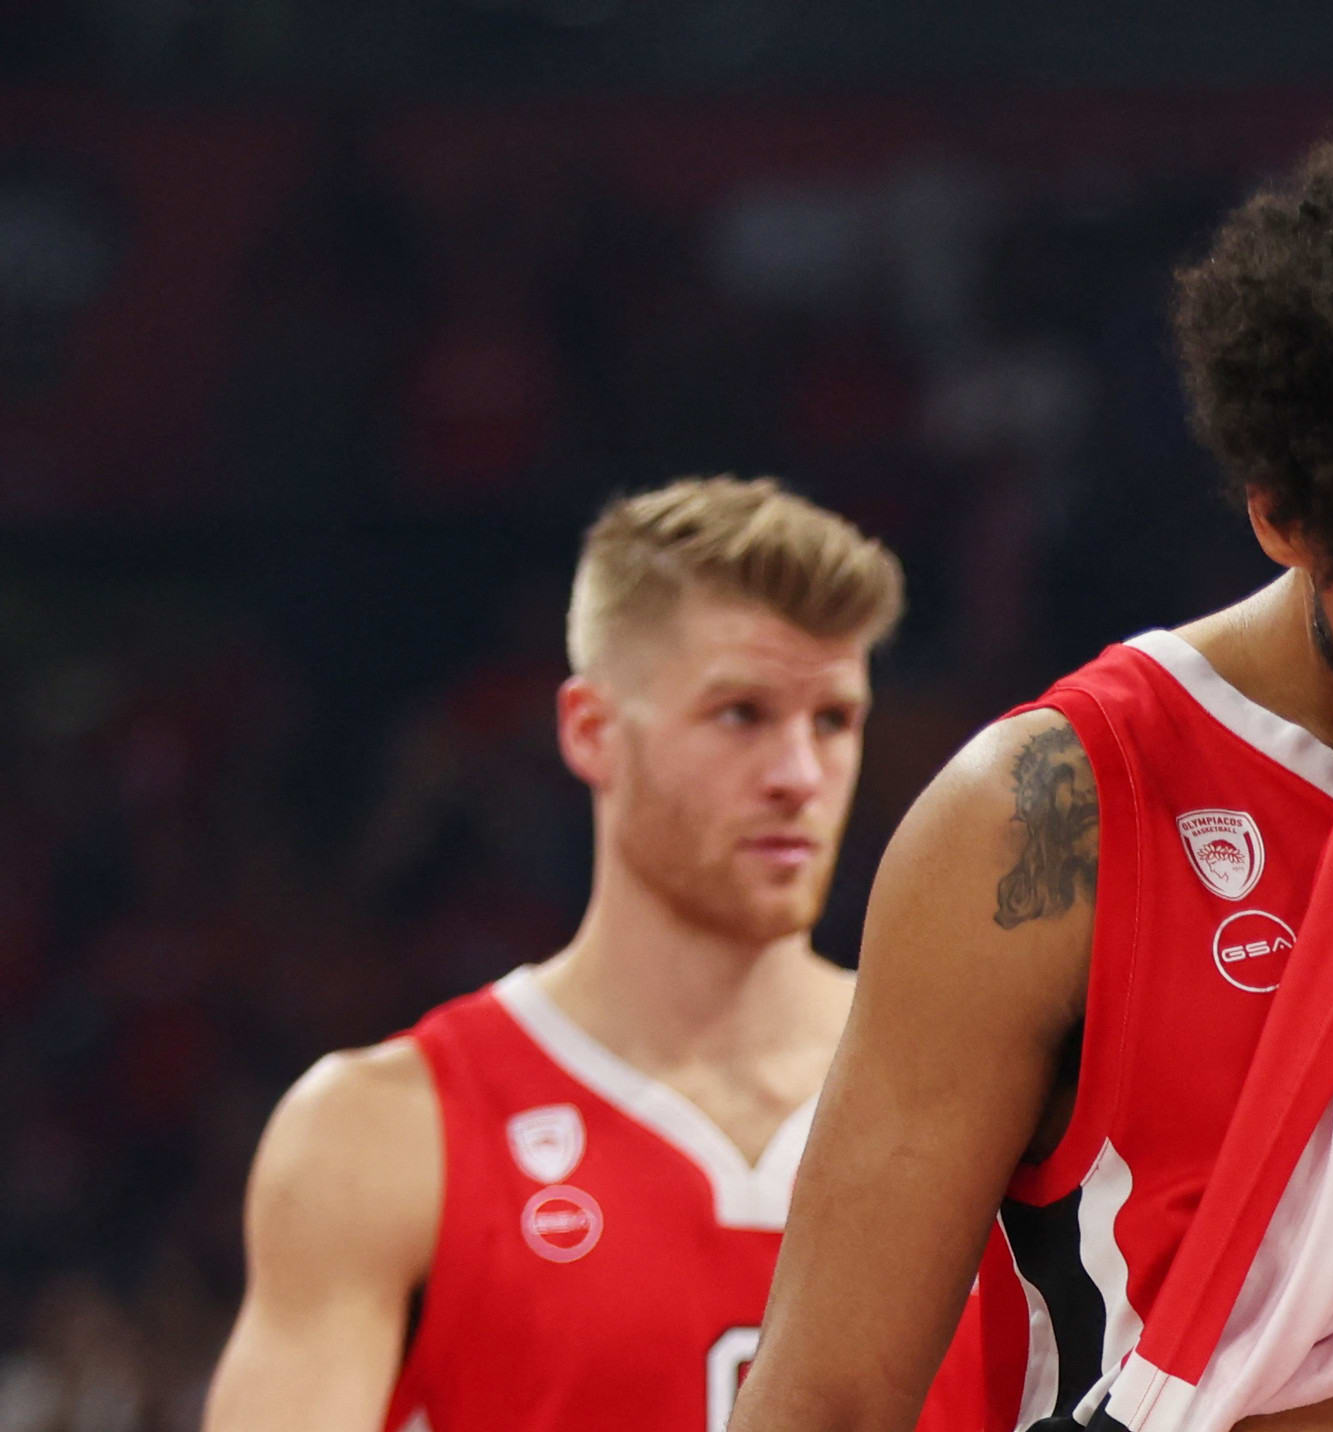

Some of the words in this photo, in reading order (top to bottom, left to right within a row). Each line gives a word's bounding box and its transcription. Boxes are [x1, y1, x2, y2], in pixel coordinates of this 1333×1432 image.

[1181, 816, 1244, 832] OLYMPIACOS
[1191, 825, 1238, 837] BASKETBALL
[1221, 937, 1293, 963] GSA
